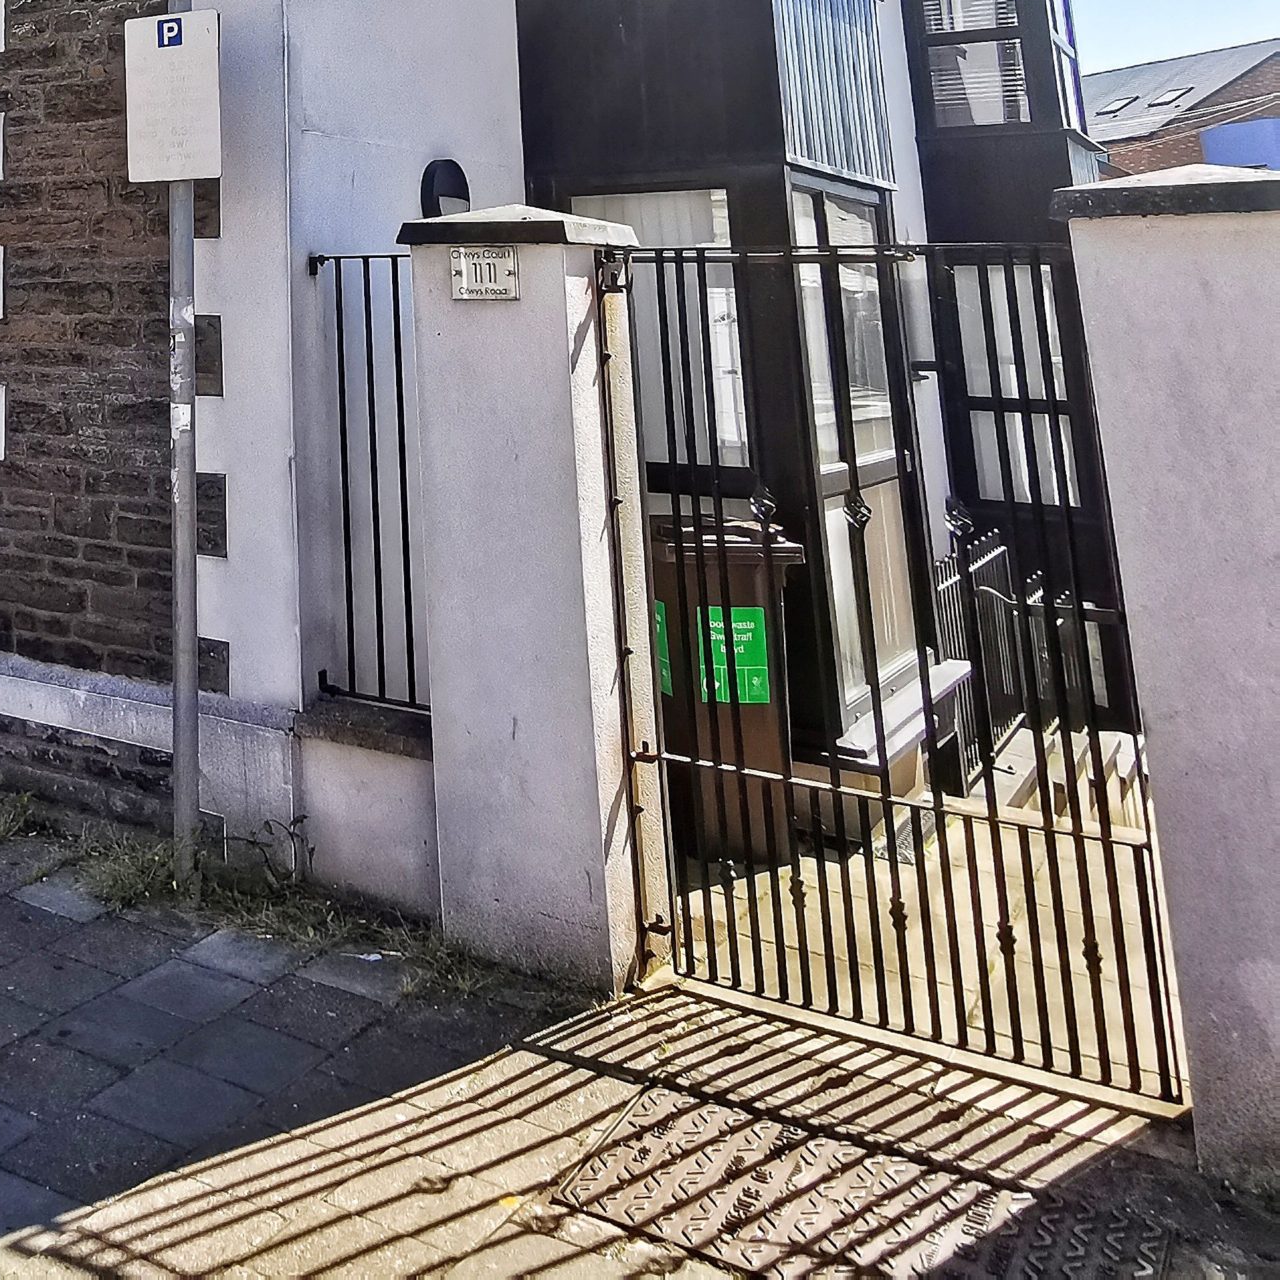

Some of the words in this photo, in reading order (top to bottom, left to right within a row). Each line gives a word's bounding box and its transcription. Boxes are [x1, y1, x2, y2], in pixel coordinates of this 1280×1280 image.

[162, 21, 179, 45] P
[483, 249, 510, 259] Court
[484, 286, 508, 295] Road
[720, 644, 745, 654] byd
